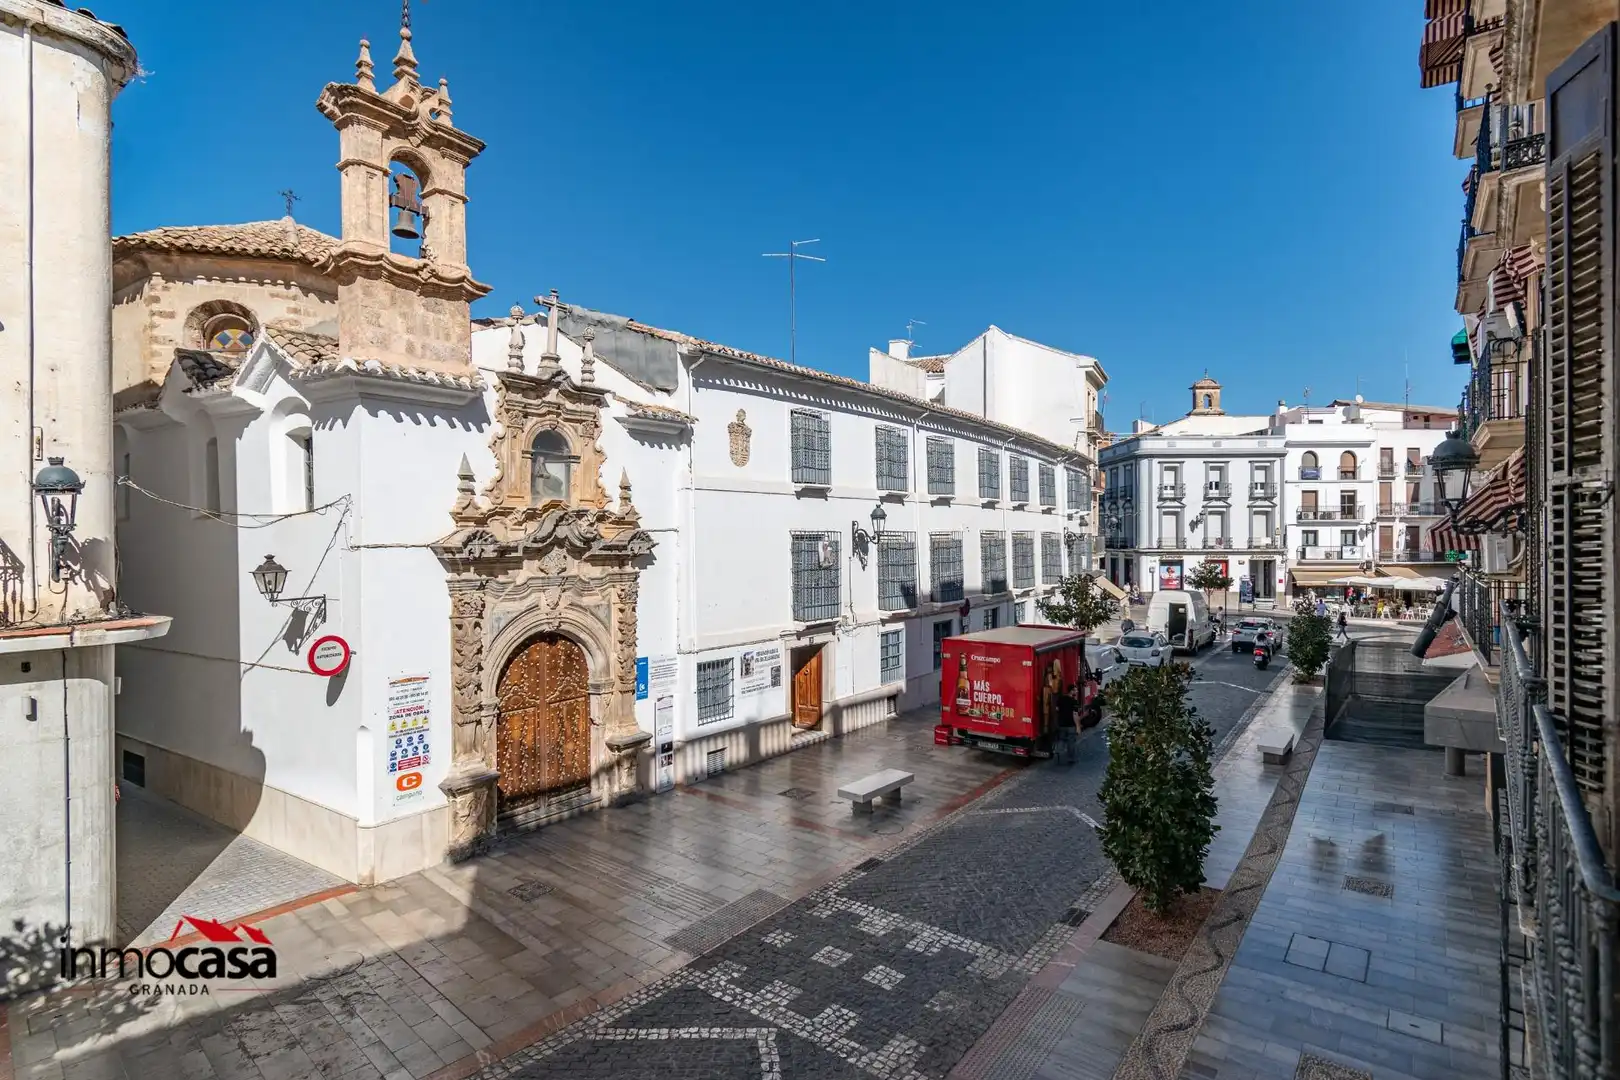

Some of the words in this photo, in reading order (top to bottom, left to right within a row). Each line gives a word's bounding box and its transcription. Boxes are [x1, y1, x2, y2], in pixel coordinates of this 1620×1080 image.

[971, 654, 1001, 663] Cruzcampo
[973, 680, 990, 692] MÁS
[973, 691, 1004, 706] CUERPO.
